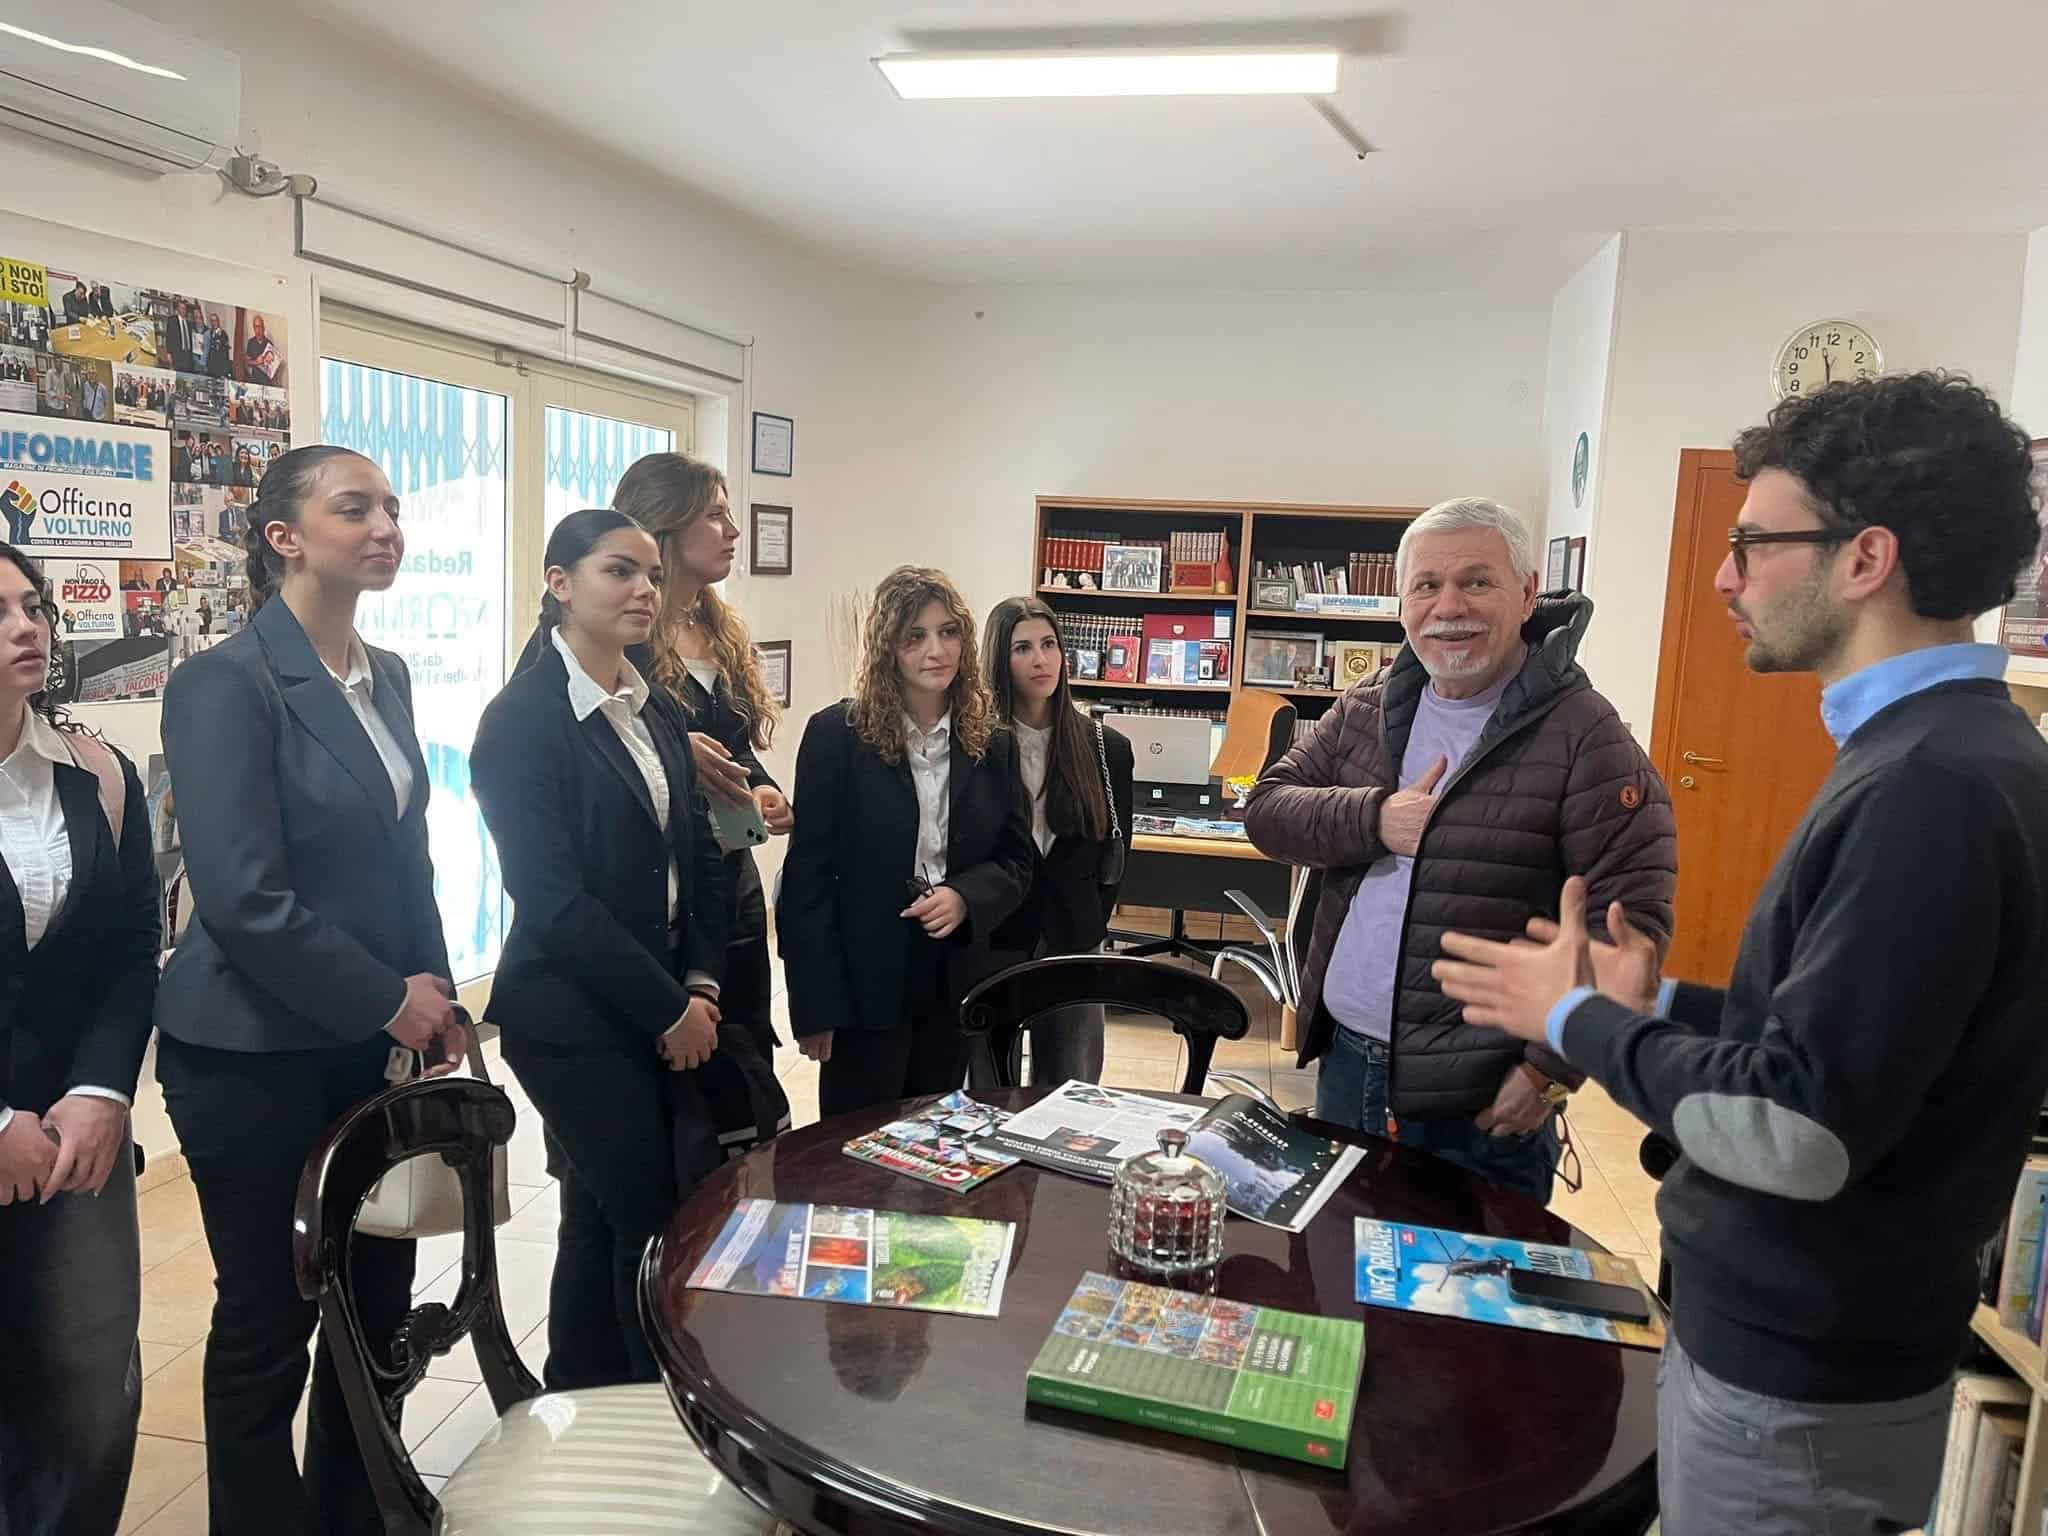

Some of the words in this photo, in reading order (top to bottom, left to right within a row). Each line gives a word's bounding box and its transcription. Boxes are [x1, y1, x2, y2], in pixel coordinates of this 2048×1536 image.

[9, 263, 42, 283] NON
[1809, 335, 1819, 348] 11
[1826, 333, 1840, 345] 12
[1848, 338, 1854, 350] 1
[1795, 347, 1808, 360] 10
[1854, 351, 1864, 364] 2
[1789, 362, 1798, 374] 9
[1790, 379, 1800, 392] 8
[40, 488, 132, 518] Officina
[43, 517, 132, 537] VOLTURNO
[62, 584, 111, 600] PIZZO
[77, 609, 113, 620] Officina
[1366, 1226, 1397, 1302] INFORMARE
